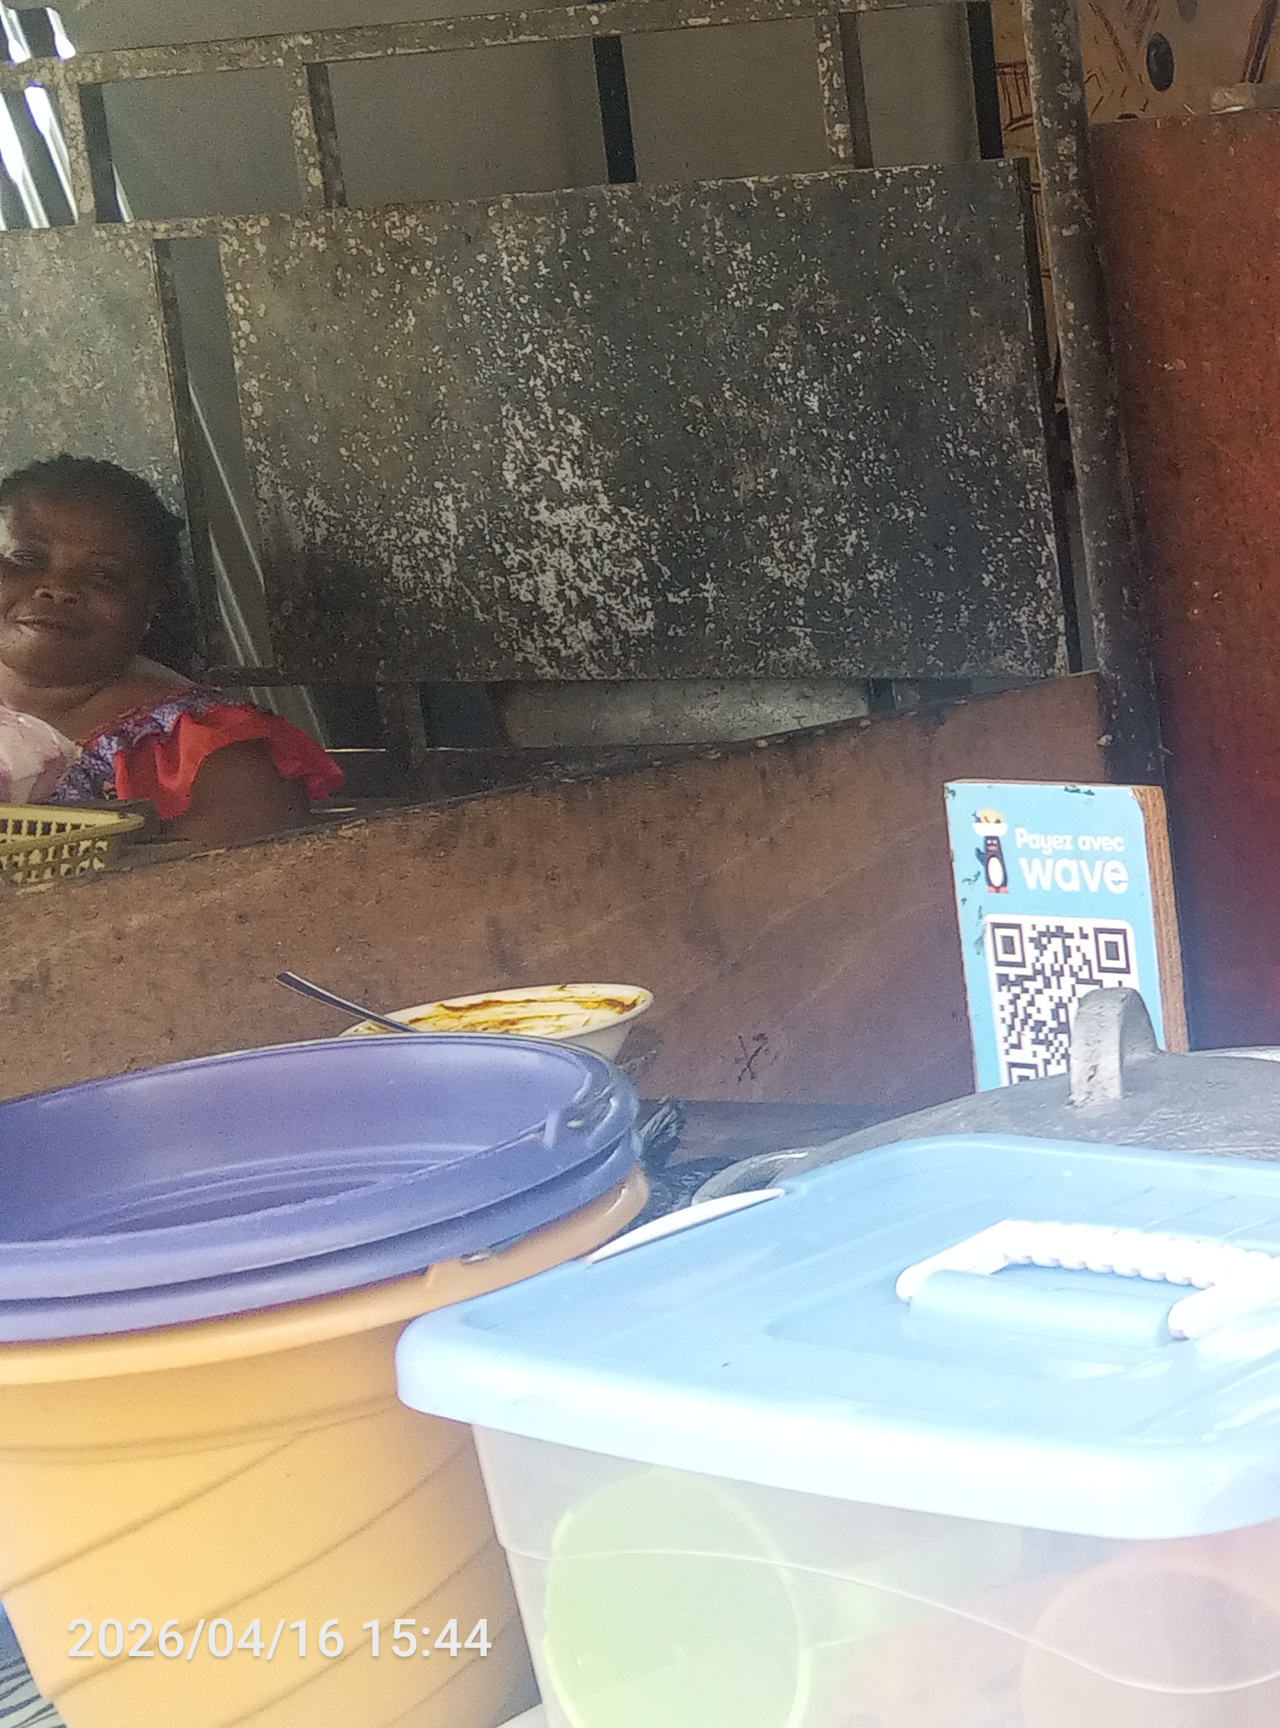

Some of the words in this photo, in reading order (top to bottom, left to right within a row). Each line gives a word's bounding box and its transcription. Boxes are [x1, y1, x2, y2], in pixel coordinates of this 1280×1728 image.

[1014, 827, 1073, 855] Payez
[1078, 833, 1125, 851] avec
[1019, 857, 1129, 894] wave
